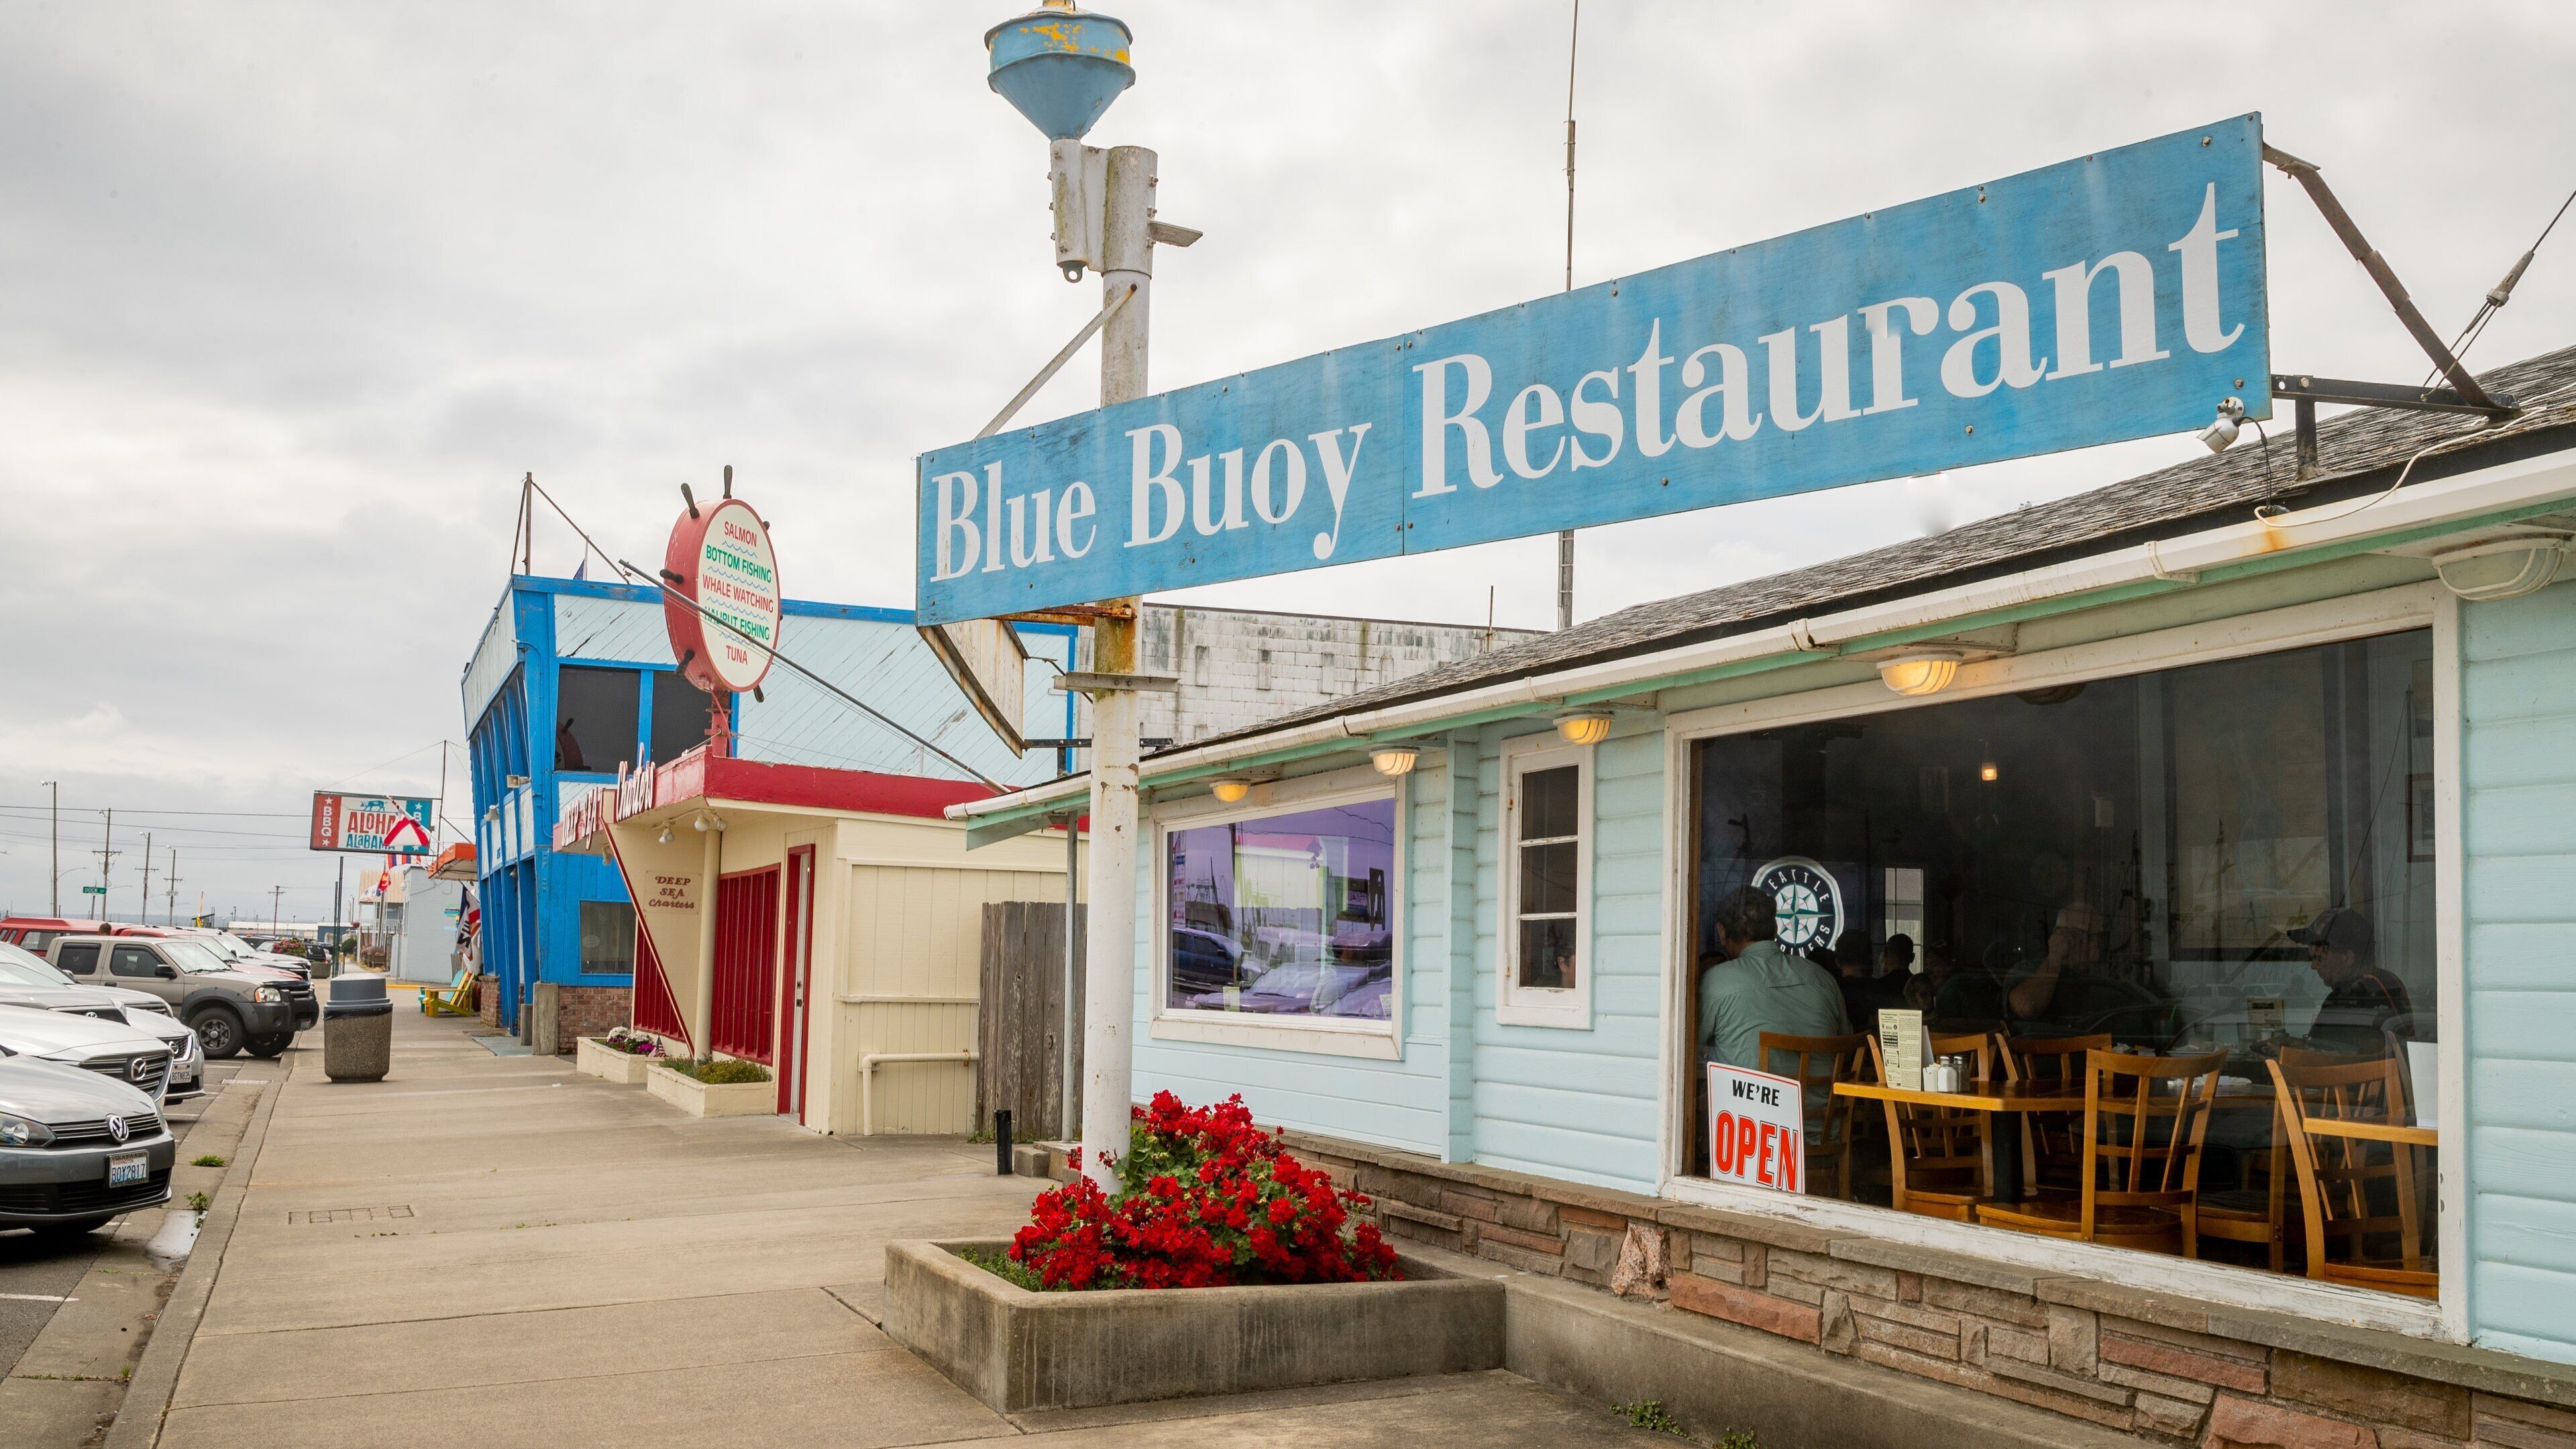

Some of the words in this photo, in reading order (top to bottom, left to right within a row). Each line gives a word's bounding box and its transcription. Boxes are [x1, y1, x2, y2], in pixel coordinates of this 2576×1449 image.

[930, 460, 1097, 583] Blue
[1124, 423, 1372, 560] Buoy
[1411, 181, 2246, 500] Restaurant
[724, 521, 757, 547] SALMON
[706, 544, 740, 570] BOTTOM
[742, 559, 771, 583] FISHING
[702, 574, 731, 598] WHALE
[733, 586, 773, 613] WATCHING
[740, 619, 770, 641] FISHING
[726, 645, 748, 665] TUNA
[321, 806, 332, 837] BBQ
[655, 876, 691, 885] DEEP
[659, 888, 685, 899] SEA
[1766, 869, 1829, 902] EATTLE
[649, 899, 694, 908] Charters
[1732, 1079, 1780, 1107] WE'RE
[112, 1152, 147, 1161] VOLKSWAGEN
[1715, 1110, 1799, 1193] OPEN
